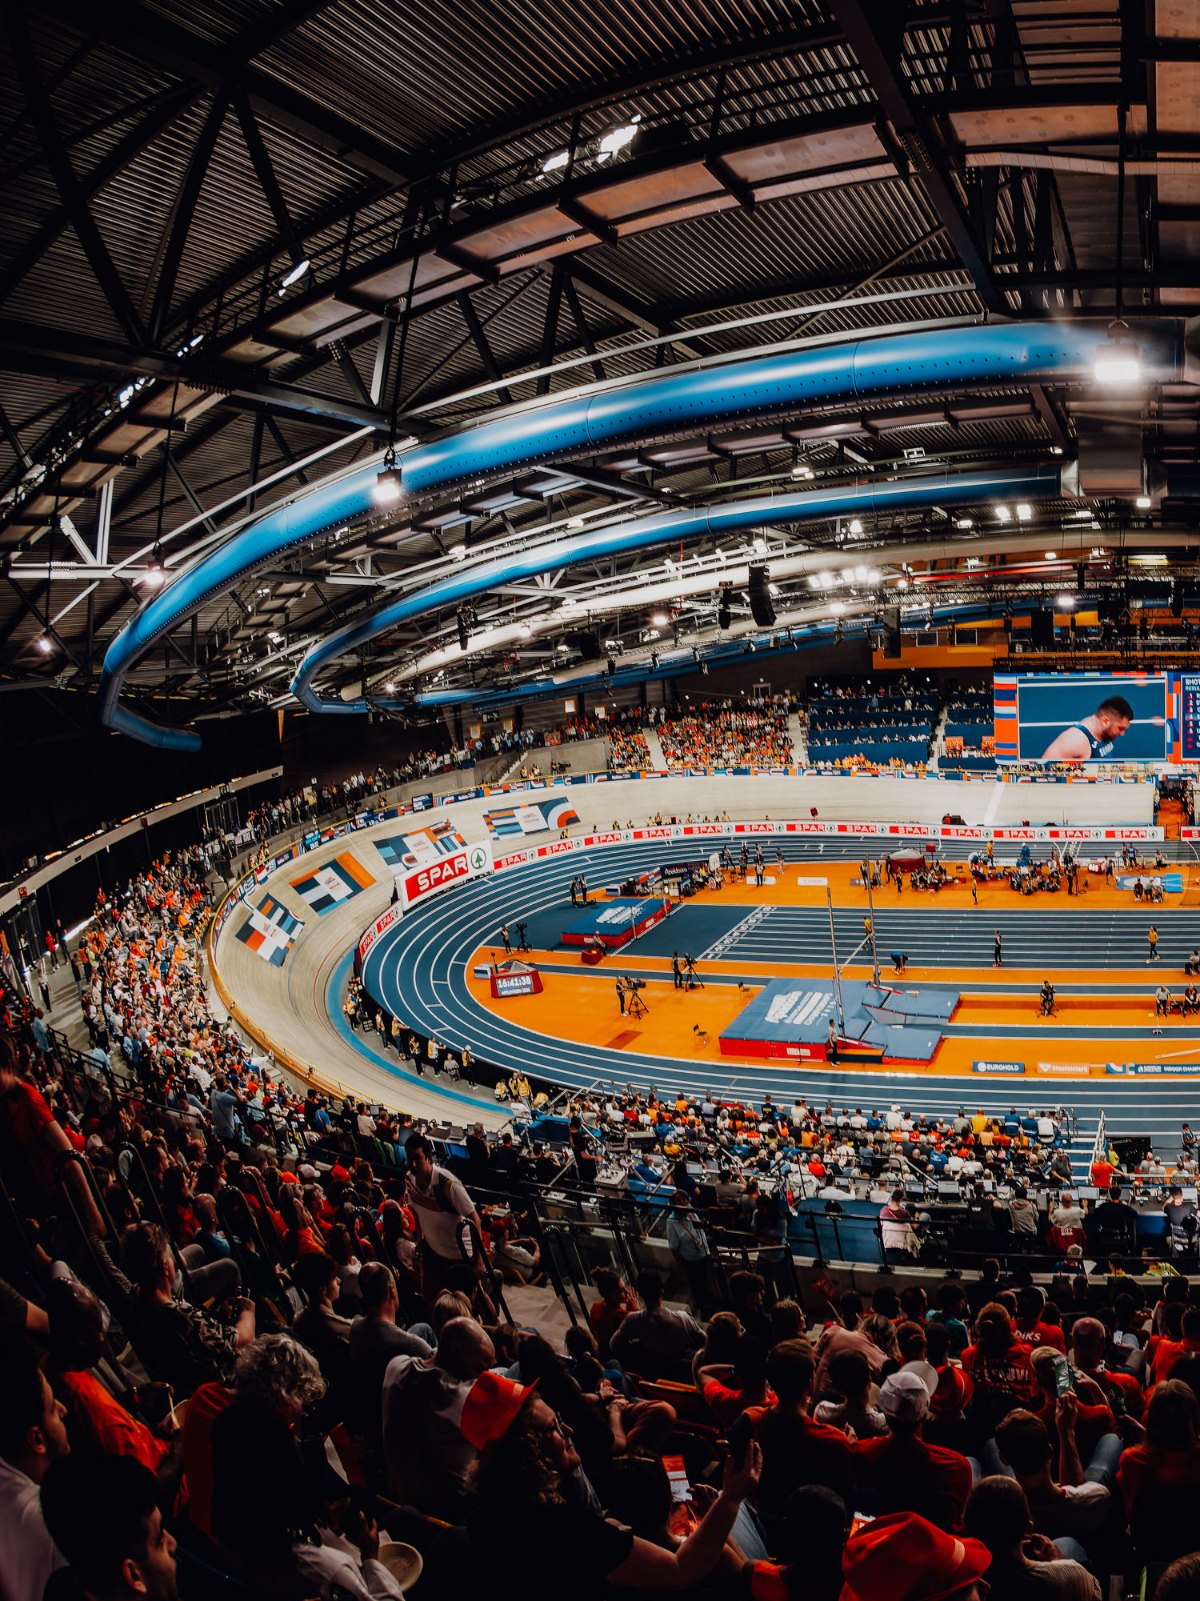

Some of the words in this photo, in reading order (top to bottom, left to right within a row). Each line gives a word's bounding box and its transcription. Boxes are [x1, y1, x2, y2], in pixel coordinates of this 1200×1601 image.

[693, 825, 723, 836] SPAR
[744, 824, 774, 834] SPAR
[796, 824, 825, 833] SPAR
[847, 825, 876, 834] SPAR
[899, 827, 928, 836] SPAR
[951, 829, 981, 838] SPAR
[642, 828, 671, 840] SPAR
[1003, 831, 1035, 839] SPAR
[1059, 831, 1090, 839] SPAR
[1115, 831, 1147, 839] SPAR
[593, 833, 622, 846] SPAR
[546, 843, 573, 857] SPAR
[501, 854, 527, 867] SPAR
[417, 857, 467, 892] SPAR
[379, 913, 395, 932] SPAR
[498, 975, 531, 988] 16:41:38
[986, 1063, 1019, 1072] EUROHOLD
